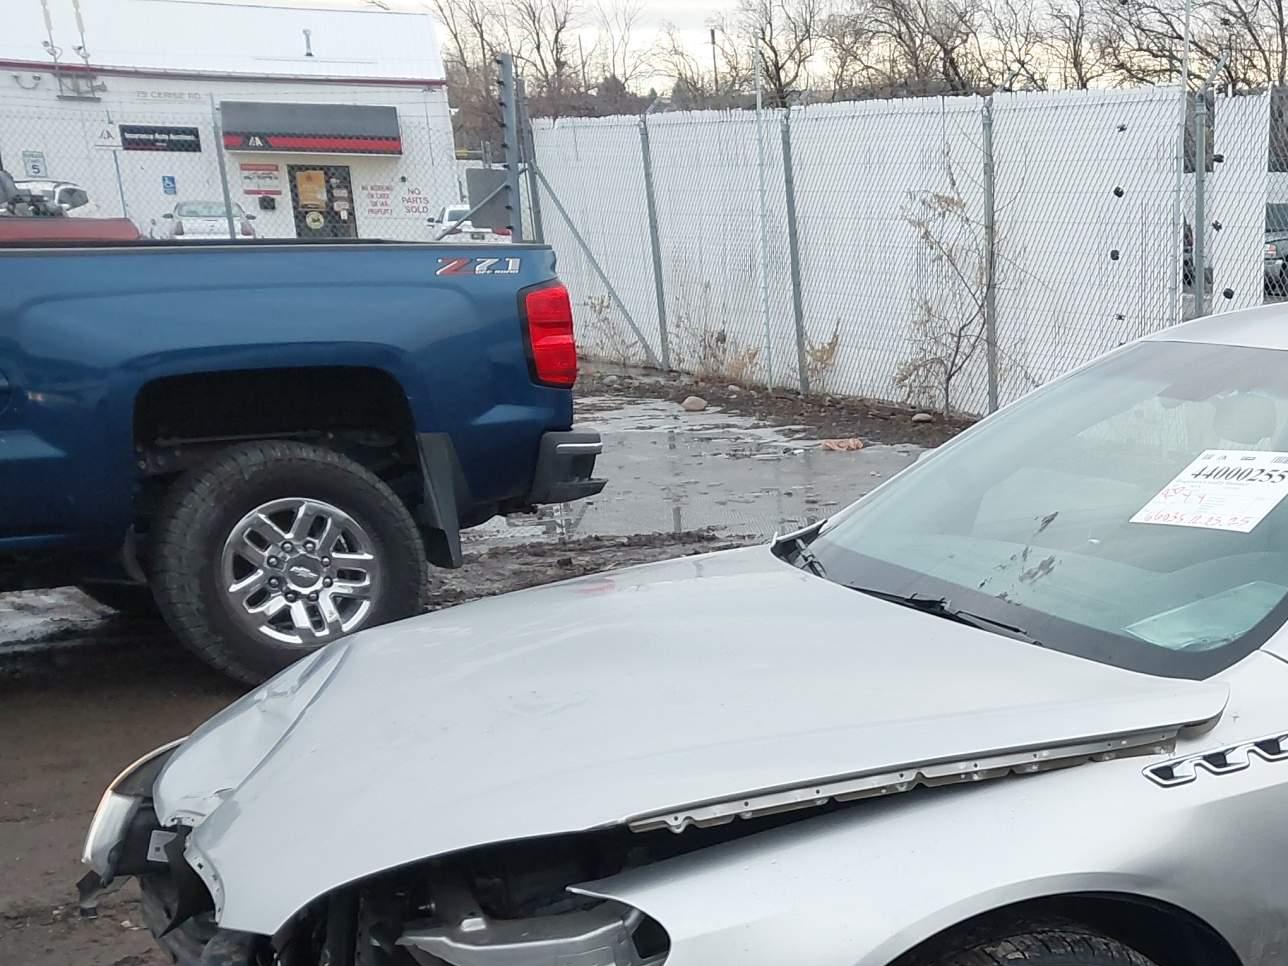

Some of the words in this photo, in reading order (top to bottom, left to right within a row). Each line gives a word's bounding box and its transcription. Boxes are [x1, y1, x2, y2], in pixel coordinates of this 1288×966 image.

[31, 164, 41, 174] 5
[407, 187, 421, 196] NO
[401, 196, 430, 205] PARTS
[405, 205, 429, 214] SOLD
[435, 256, 522, 277] Z71
